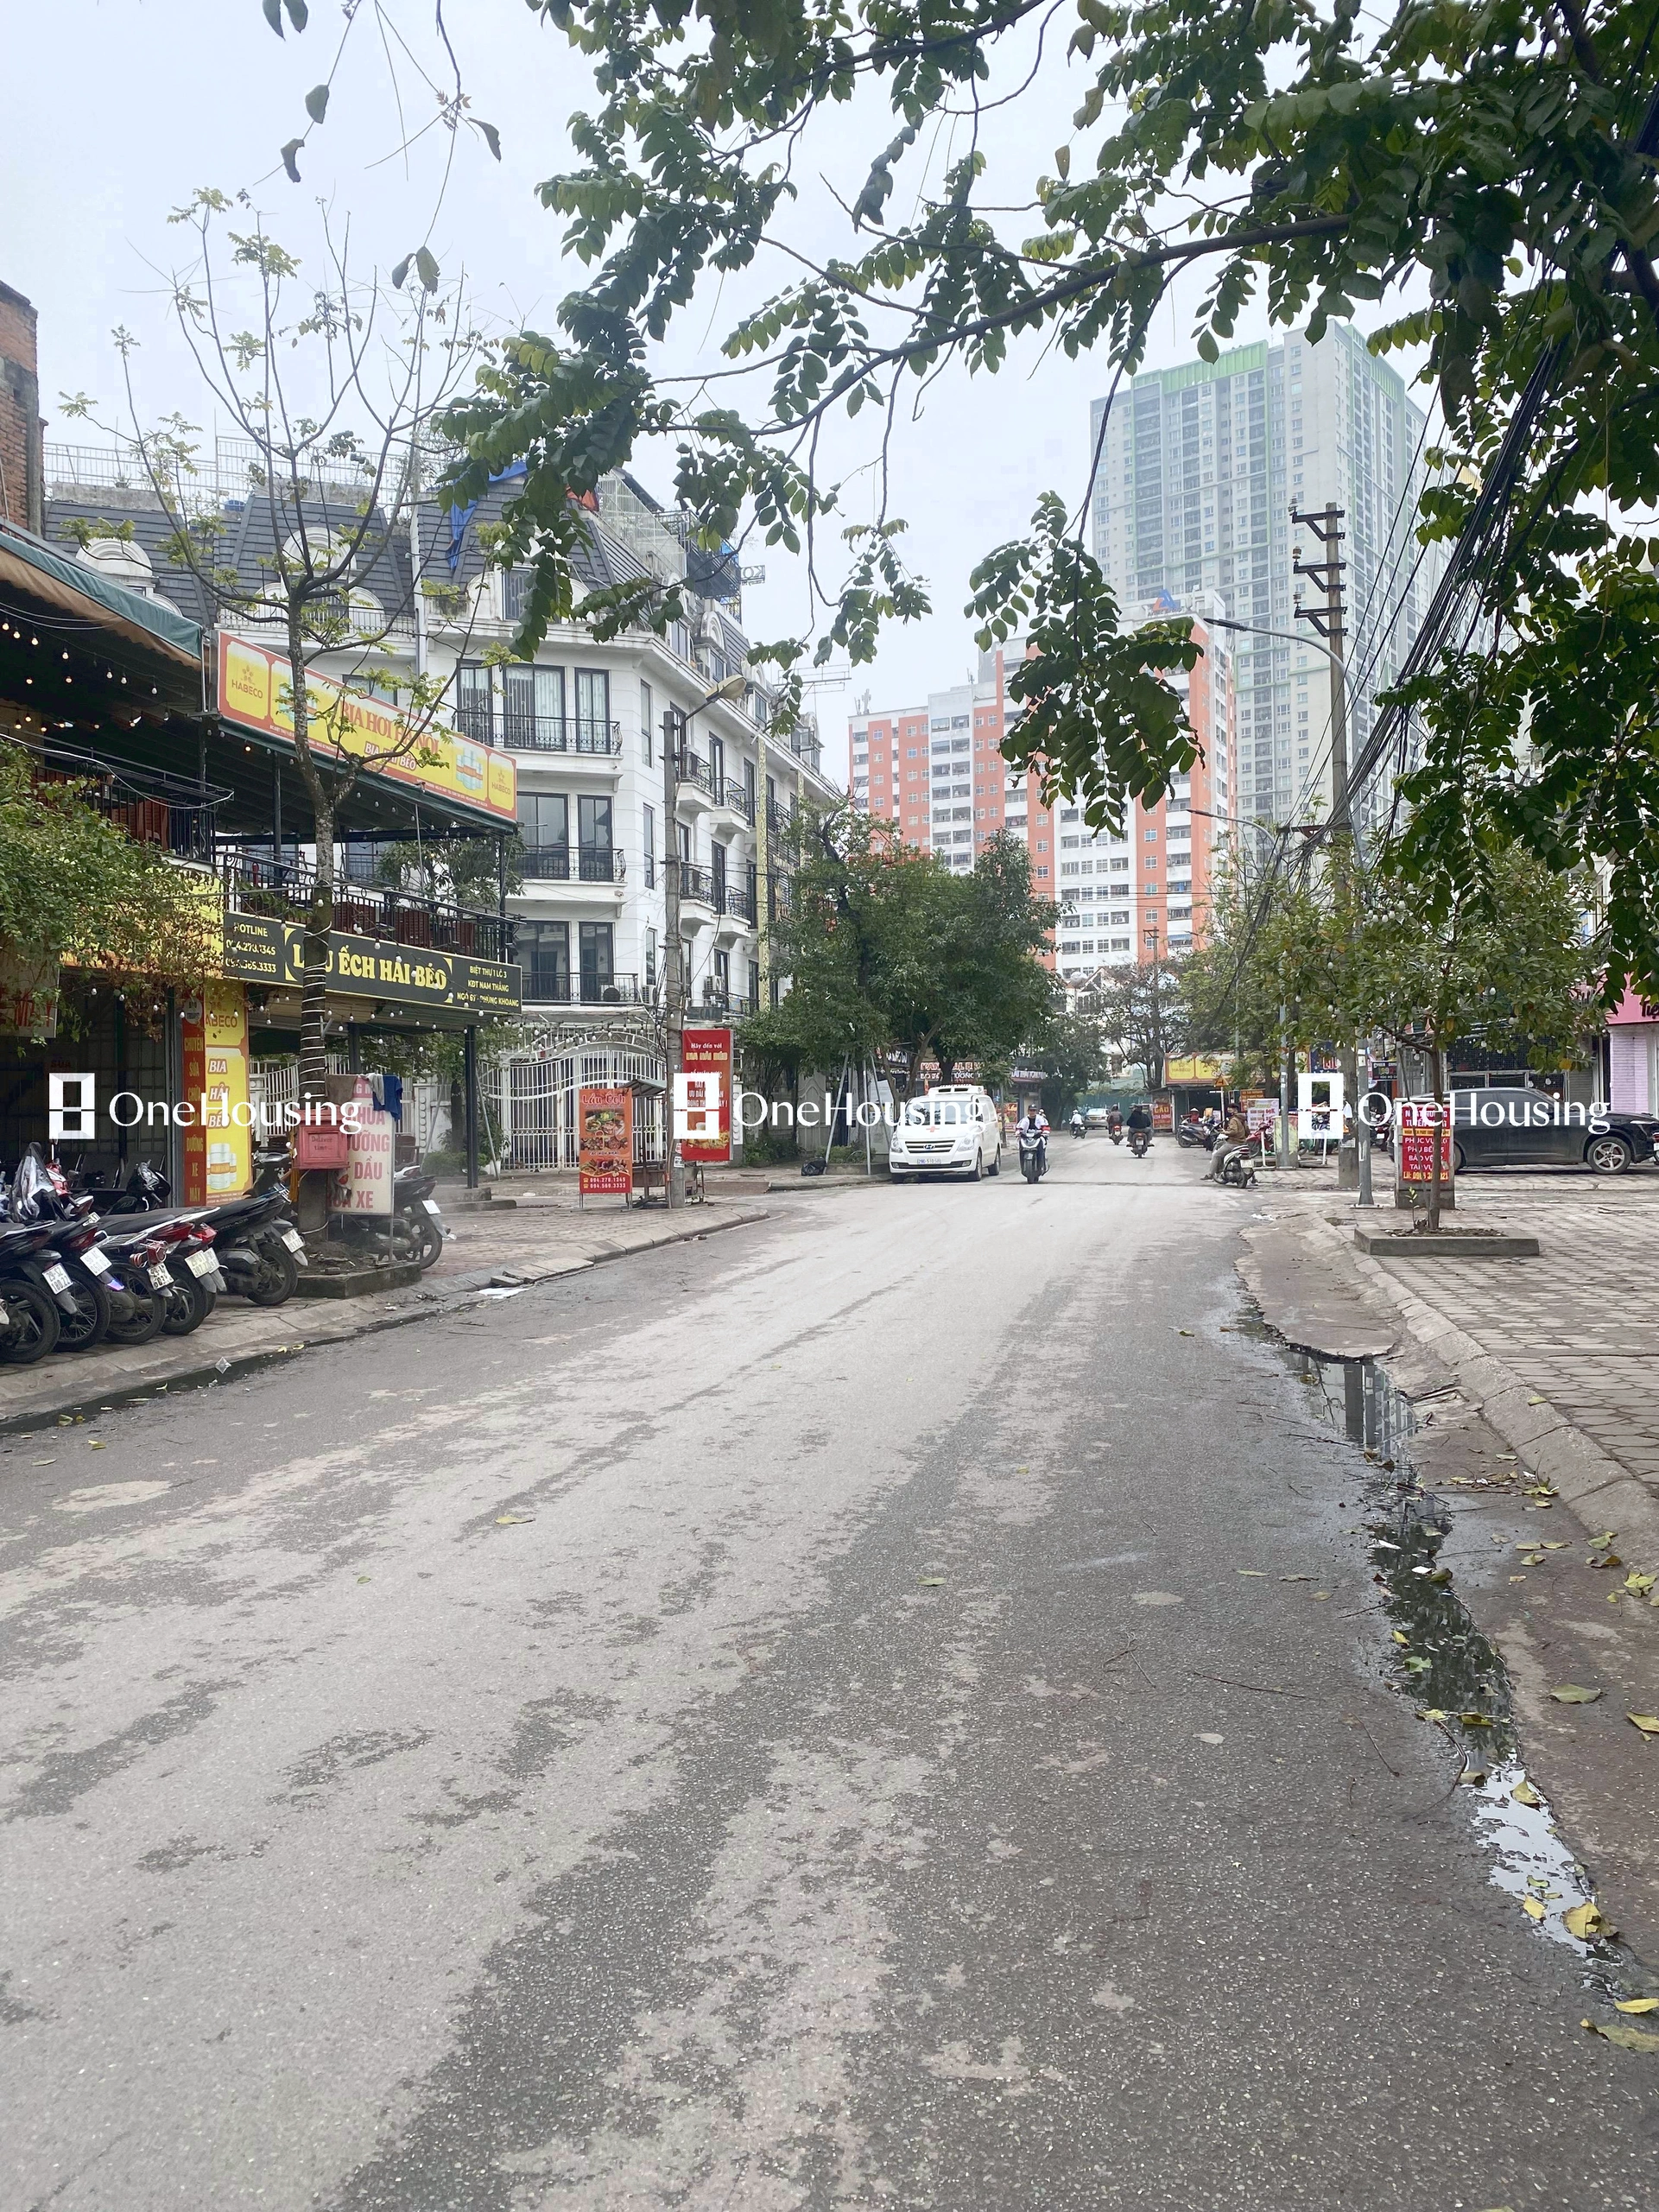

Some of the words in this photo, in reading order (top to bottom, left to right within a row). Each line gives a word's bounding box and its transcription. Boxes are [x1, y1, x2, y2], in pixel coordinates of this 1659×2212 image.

[231, 679, 263, 699] HABECO
[340, 700, 364, 729] BIA
[364, 741, 379, 756] BIA
[399, 754, 416, 770] BÉO
[491, 782, 511, 795] HABECO
[293, 944, 333, 973] LU
[339, 945, 375, 979] ẾCH
[415, 962, 446, 990] BÉO
[479, 981, 491, 990] NAM
[497, 996, 519, 1007] KHOANG
[206, 1014, 237, 1028] ABECO
[209, 1059, 227, 1074] BIA
[354, 1155, 383, 1180] DẦU
[356, 1190, 374, 1209] XE
